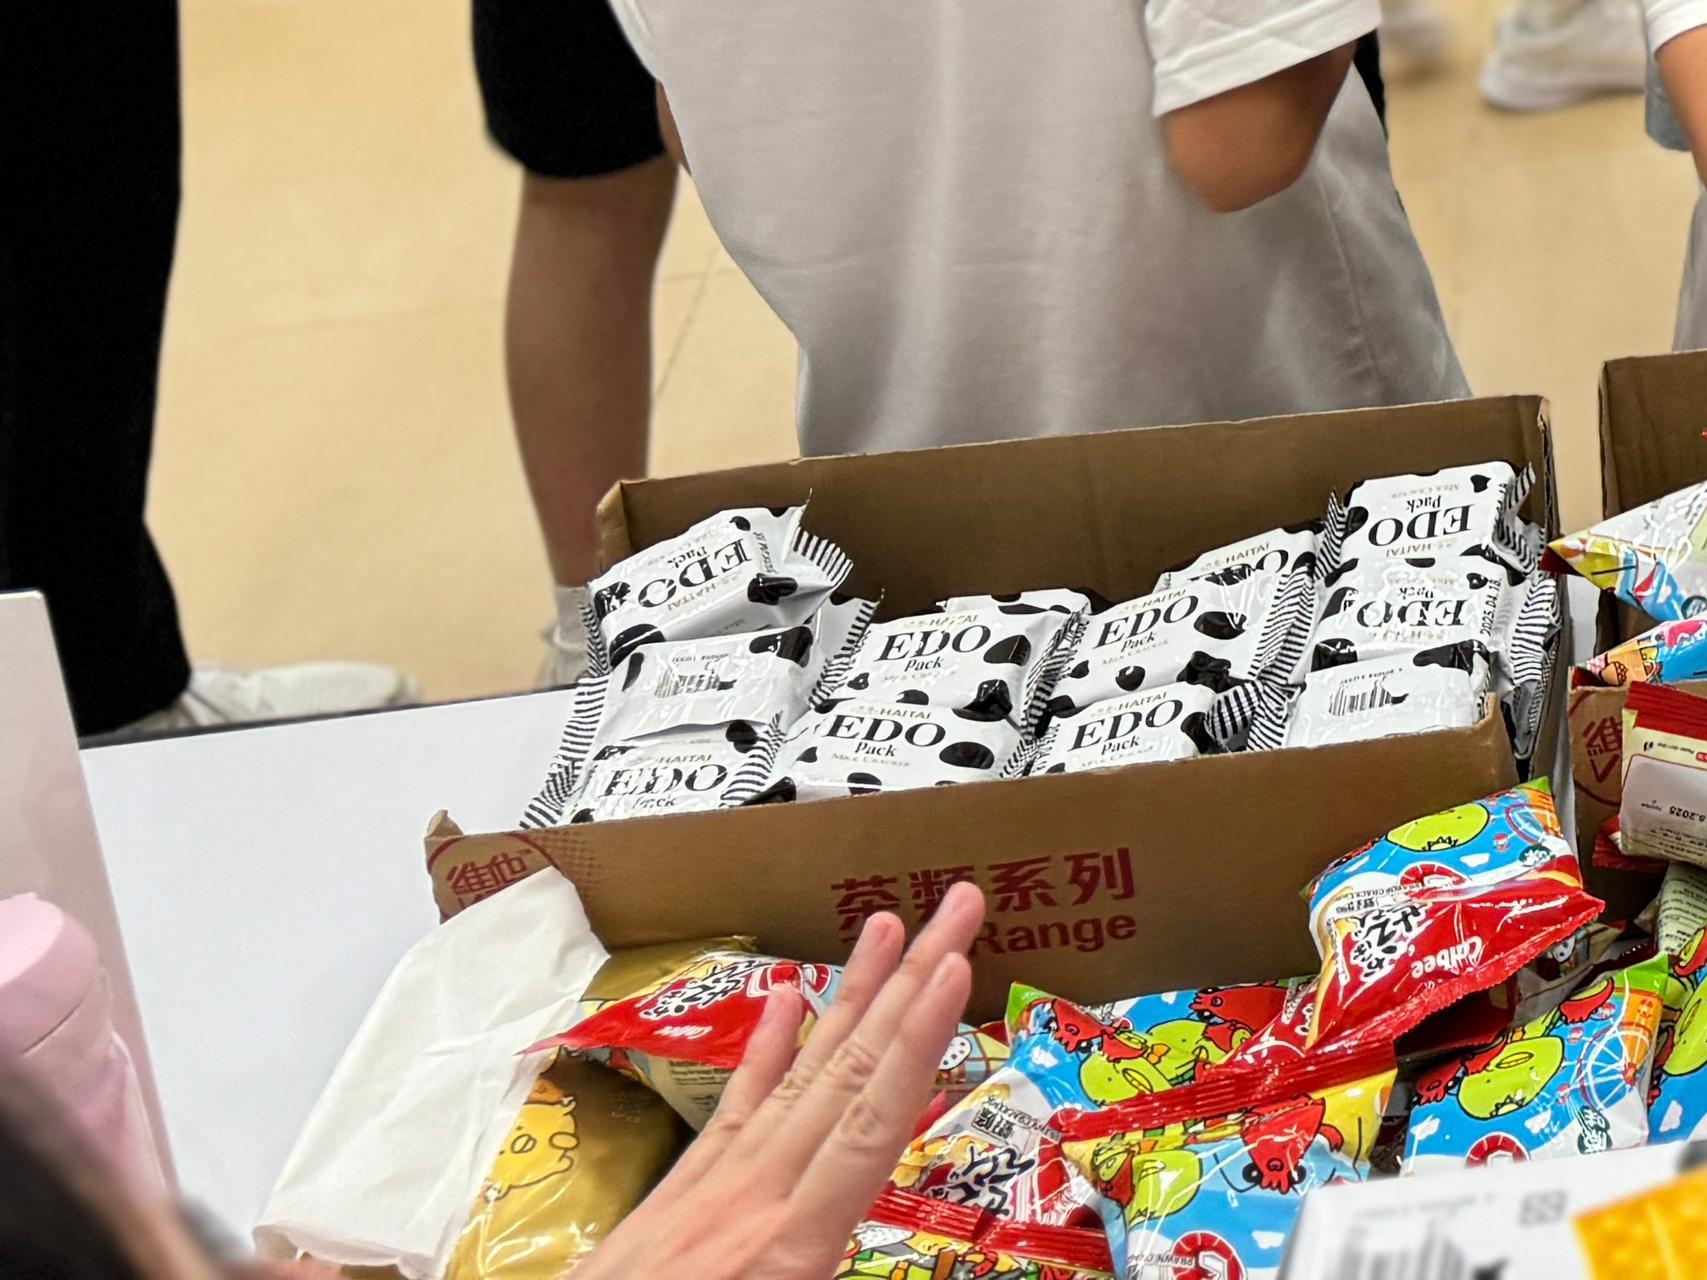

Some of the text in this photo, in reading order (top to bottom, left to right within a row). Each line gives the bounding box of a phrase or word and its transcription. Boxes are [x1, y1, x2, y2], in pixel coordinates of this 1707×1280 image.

[1405, 494, 1443, 514] Pack
[1368, 504, 1475, 547] EDO
[1385, 542, 1436, 558] HAITAI
[1094, 595, 1200, 651] EDO
[1120, 629, 1159, 651] Pack
[879, 624, 993, 663] EDO
[904, 655, 943, 672] Pack
[822, 713, 947, 752] EDO
[1067, 700, 1185, 752] EDO
[854, 741, 898, 759] Pack
[1101, 734, 1141, 756] Pack
[597, 763, 728, 799] EDO
[831, 844, 1137, 932] 茶類系列
[1410, 936, 1482, 979] Calbee
